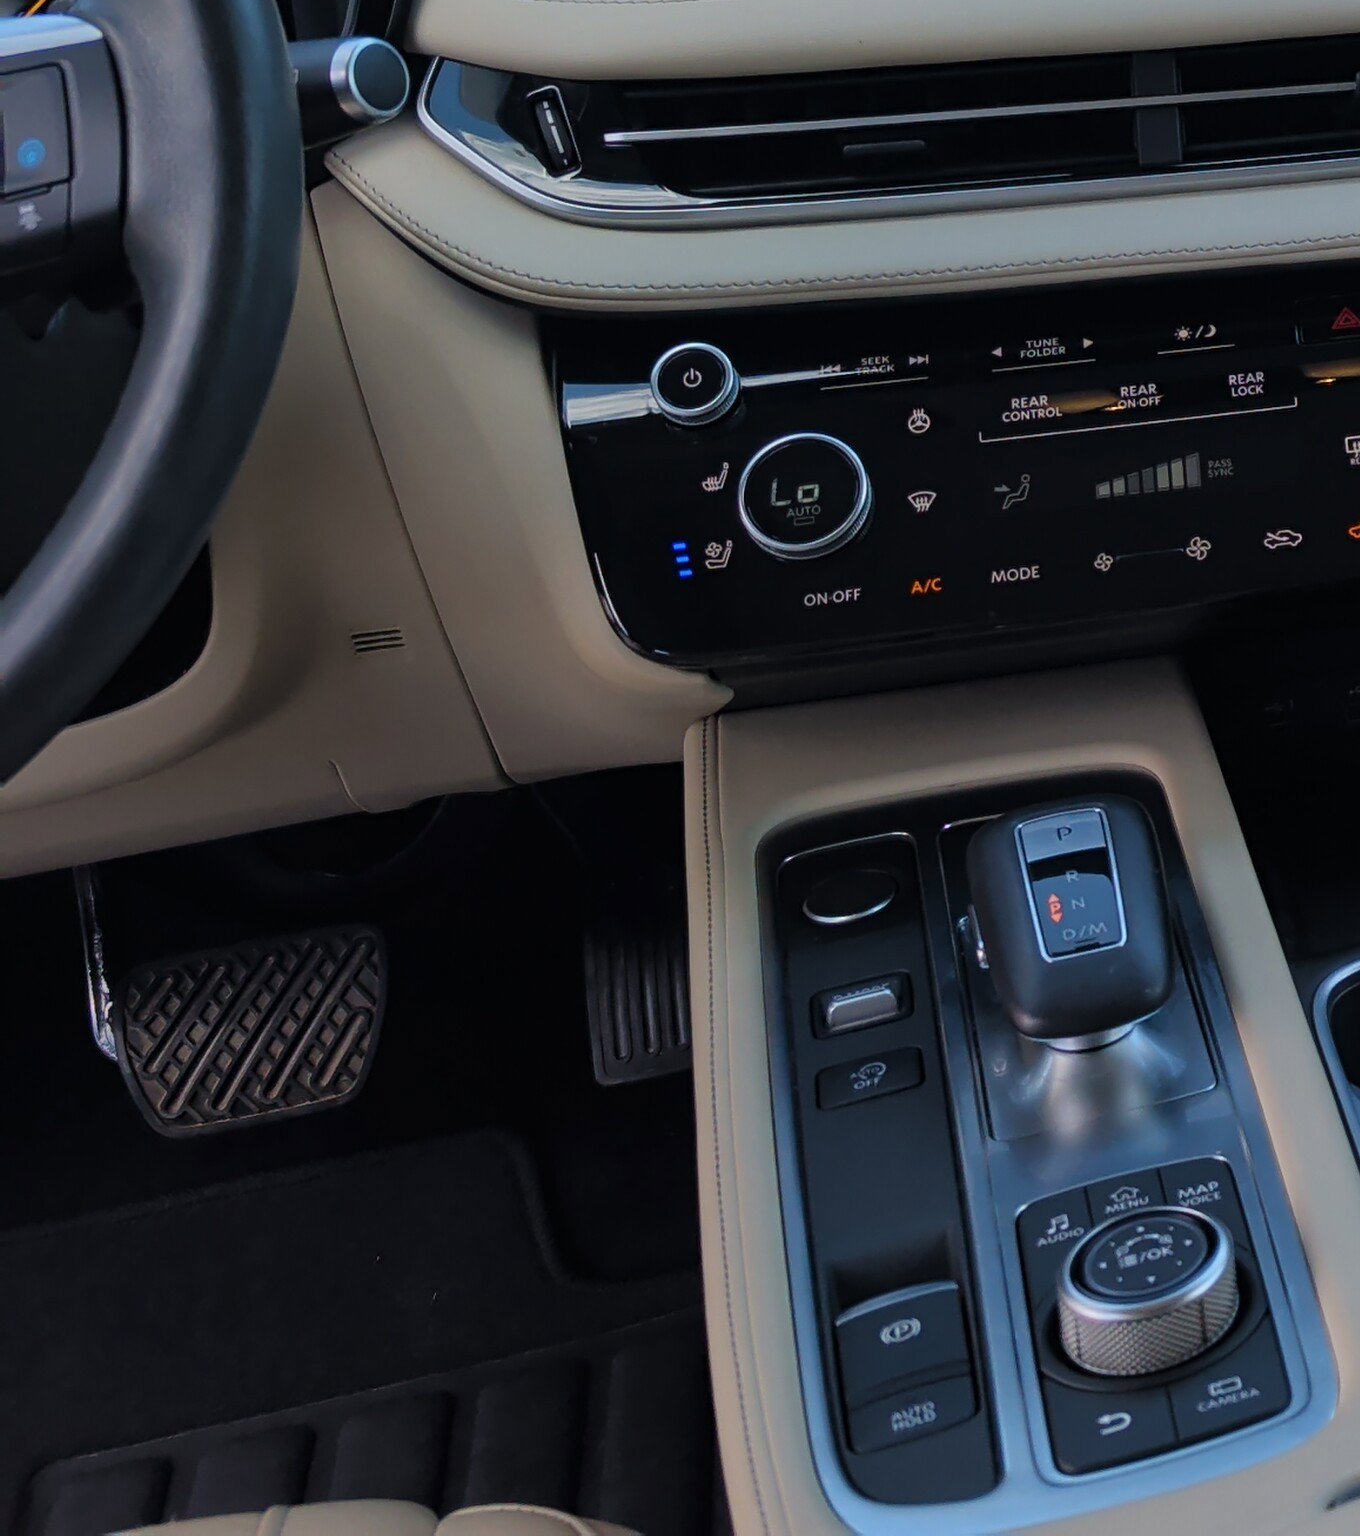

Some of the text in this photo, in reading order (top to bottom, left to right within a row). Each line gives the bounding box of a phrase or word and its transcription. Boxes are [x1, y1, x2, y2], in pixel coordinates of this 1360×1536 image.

[1025, 337, 1060, 349] TUNE
[1020, 345, 1066, 359] FOLDER
[860, 355, 890, 366] SEEK
[854, 363, 895, 375] TRACK
[1228, 371, 1265, 386] REAR
[1120, 383, 1157, 398] REAR
[1231, 384, 1264, 398] LOCK
[1011, 394, 1049, 410] REAR
[1001, 407, 1063, 423] CONTROL
[1207, 458, 1233, 469] PASS
[1207, 466, 1234, 479] SYNC
[786, 504, 821, 518] AUTO
[990, 565, 1041, 584] MODE
[910, 577, 943, 595] A/C
[1056, 826, 1073, 841] P
[1065, 869, 1080, 883] R
[1071, 896, 1086, 910] N
[1062, 921, 1109, 941] D/M
[1176, 1180, 1220, 1200] MAP
[1104, 1195, 1149, 1214] MENU
[1178, 1191, 1222, 1207] VOICE
[1036, 1227, 1085, 1247] AUDIO
